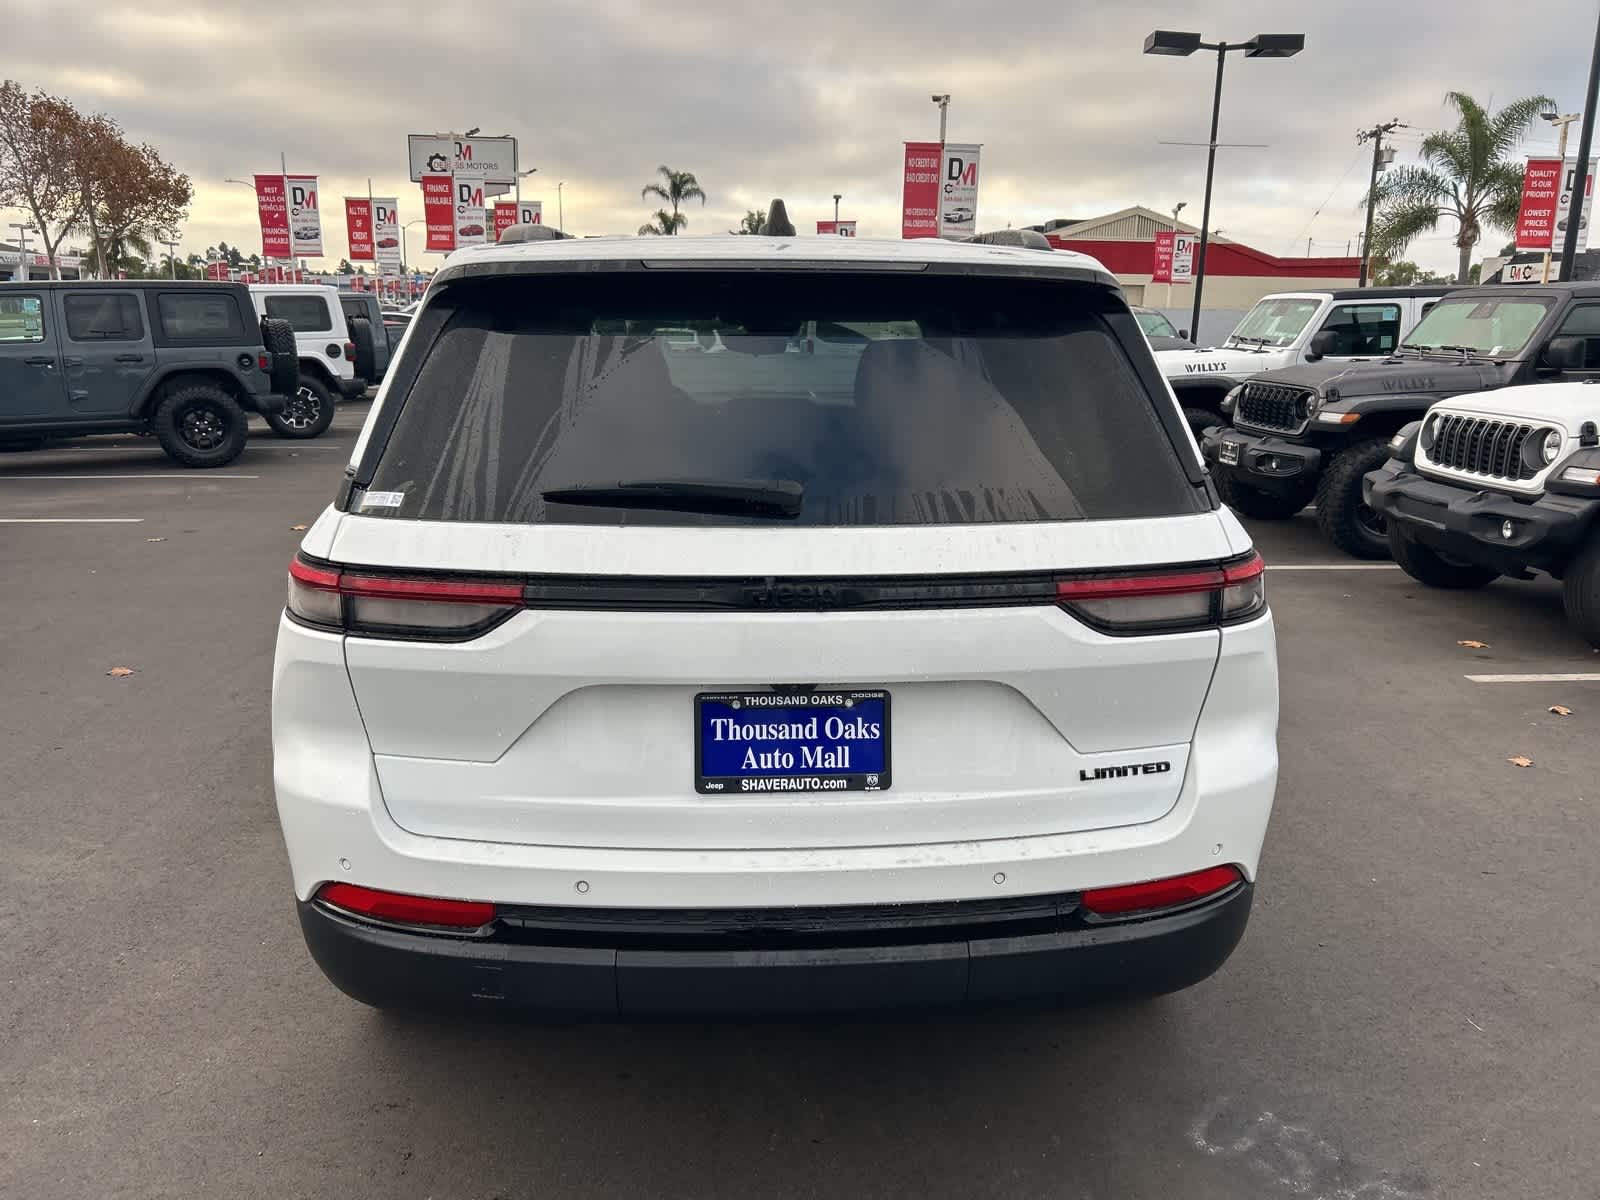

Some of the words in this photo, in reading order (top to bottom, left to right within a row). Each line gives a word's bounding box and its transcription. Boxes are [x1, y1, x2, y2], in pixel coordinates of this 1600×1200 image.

[466, 162, 498, 170] MOTORS
[948, 158, 976, 186] DM
[1529, 170, 1557, 178] QUALITY
[264, 186, 278, 194] BEST
[427, 184, 449, 192] FINANCE
[1538, 180, 1552, 188] OUR
[292, 186, 317, 210] DM
[426, 196, 452, 205] AVAILABLE
[459, 184, 483, 207] DM
[260, 204, 285, 212] VEHICLES
[1524, 209, 1552, 217] LOWEST
[376, 207, 396, 225] DM
[522, 210, 540, 224] DM
[1382, 376, 1436, 390] WILLYS
[744, 696, 808, 706] THOUSAND
[811, 695, 843, 704] OAKS
[710, 717, 818, 741] Thousand
[824, 716, 880, 740] Oaks
[741, 746, 794, 770] Auto
[800, 745, 850, 769] Mall
[1080, 760, 1171, 781] LIMITED
[706, 781, 724, 790] Jeep
[741, 778, 847, 791] SHAVERAUTO.com
